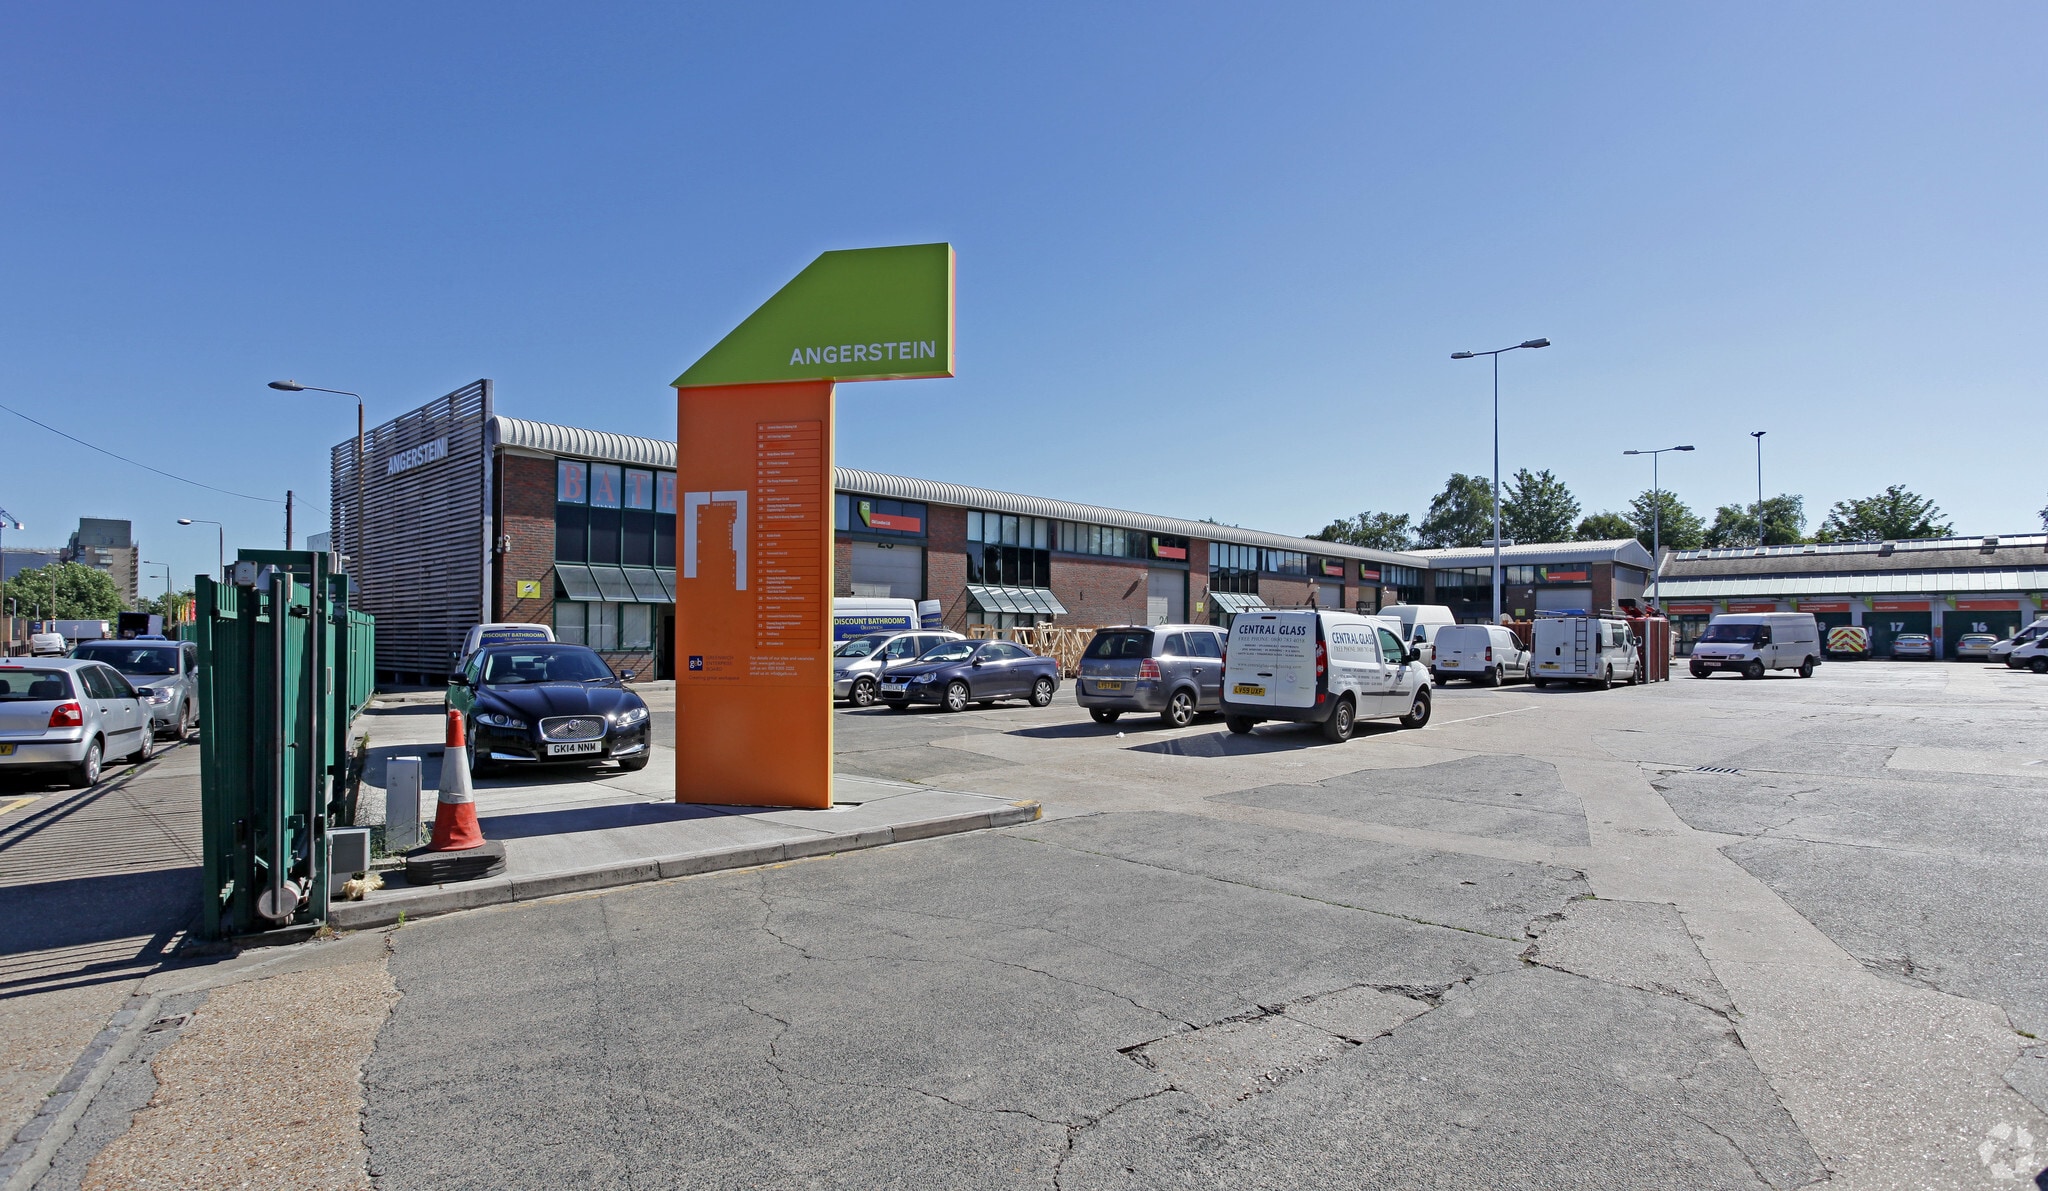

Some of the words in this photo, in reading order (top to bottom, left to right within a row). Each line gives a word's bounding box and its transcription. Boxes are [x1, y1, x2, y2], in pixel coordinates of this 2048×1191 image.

[790, 340, 936, 366] ANGERSTEIN
[388, 436, 448, 475] ANGERSTEIN
[862, 502, 870, 510] 25
[1239, 625, 1275, 634] CENTRAL
[1279, 625, 1306, 635] GLASS
[1890, 622, 1904, 632] 17
[1972, 622, 1987, 632] 16
[1332, 632, 1358, 644] CENTRAL
[1359, 634, 1374, 644] GLASS
[554, 743, 576, 753] GK14
[578, 742, 596, 751] NNM
